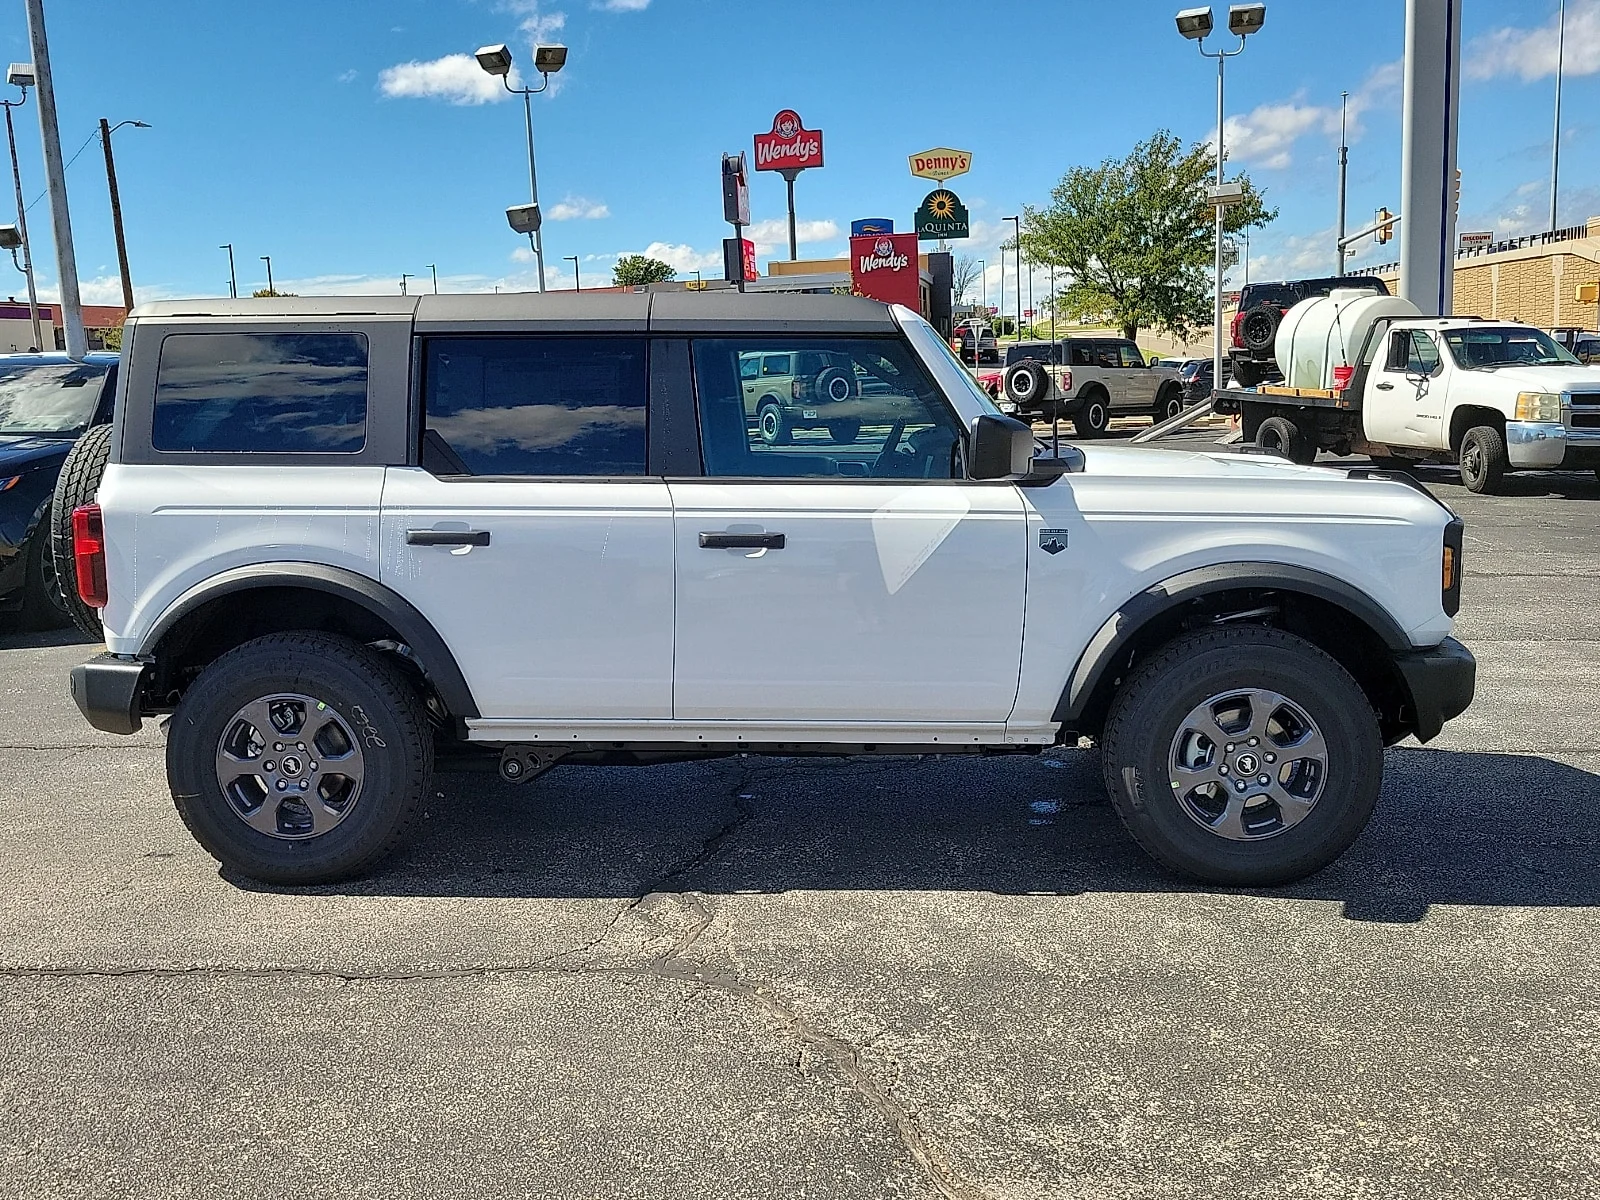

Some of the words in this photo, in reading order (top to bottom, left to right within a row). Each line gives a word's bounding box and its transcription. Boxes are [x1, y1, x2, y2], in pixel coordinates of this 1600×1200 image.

[758, 135, 819, 165] Wendy's
[915, 155, 967, 172] Denny's
[925, 222, 967, 234] QUINTA
[860, 251, 908, 274] Wendy's
